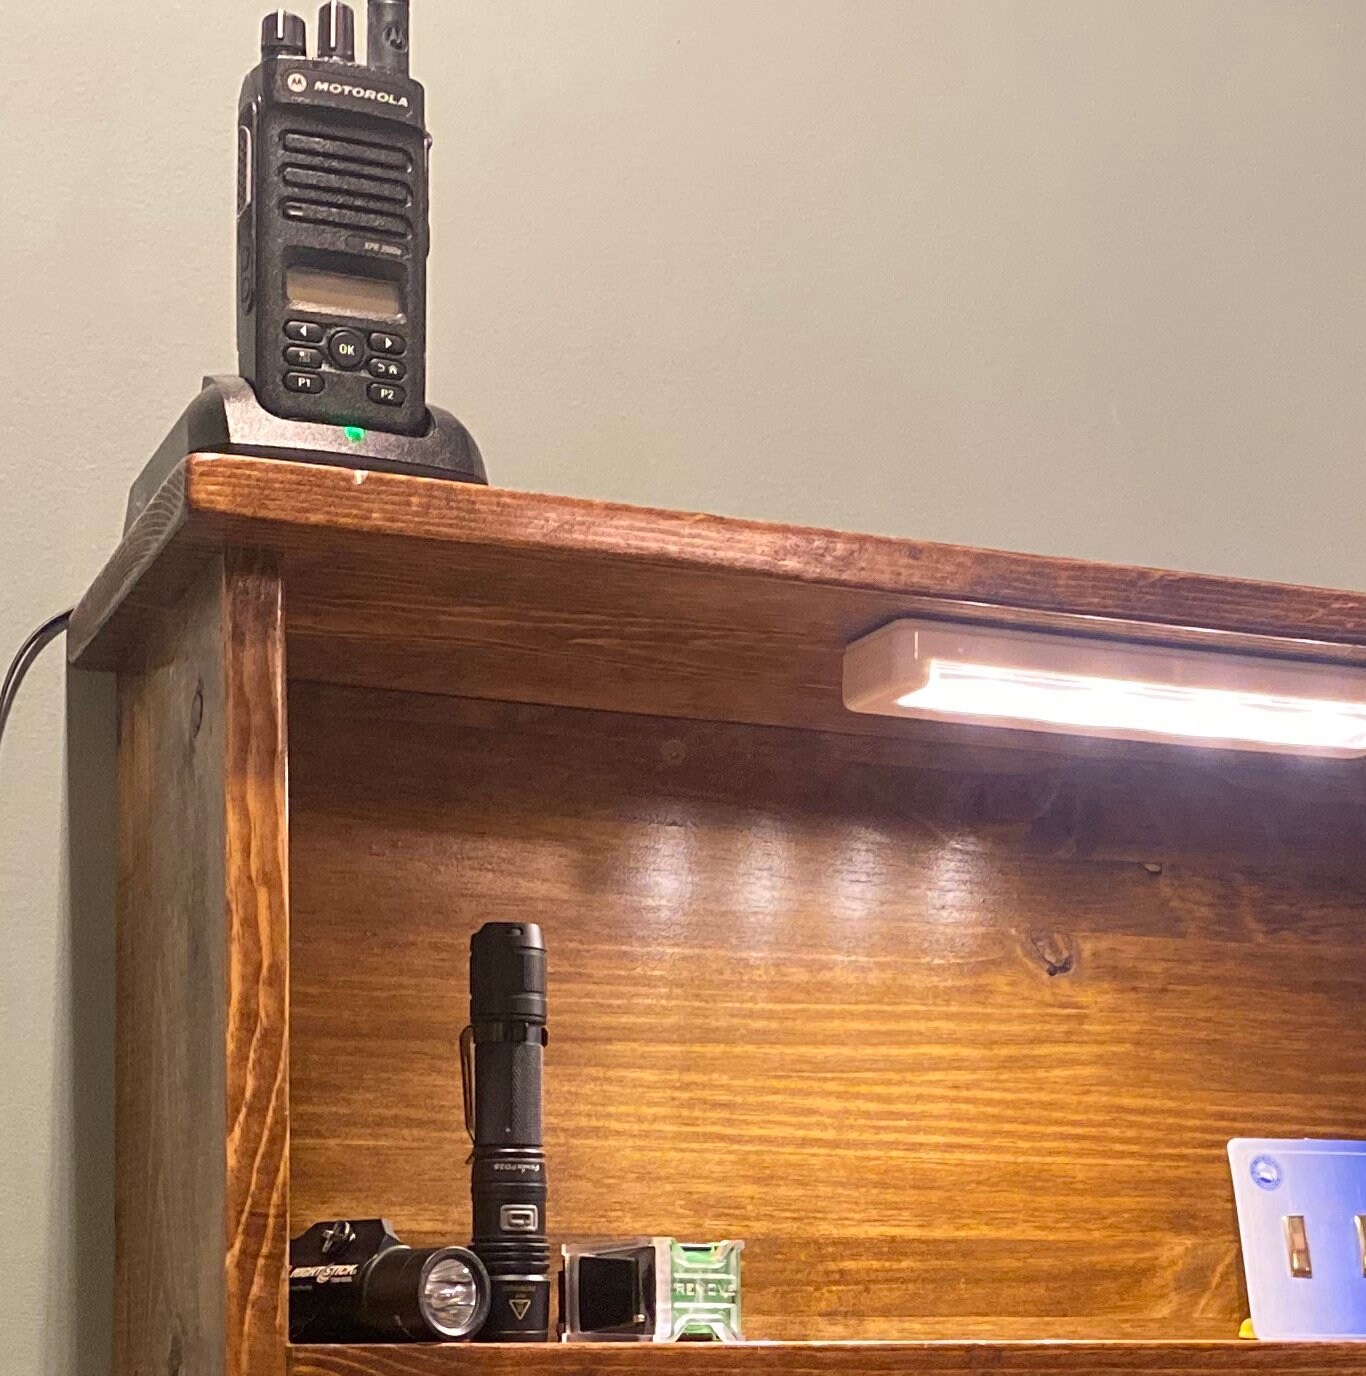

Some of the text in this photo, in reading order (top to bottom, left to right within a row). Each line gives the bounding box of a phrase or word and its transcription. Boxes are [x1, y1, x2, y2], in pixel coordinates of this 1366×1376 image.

[314, 80, 409, 108] MOTOROLA
[338, 343, 355, 356] OK
[298, 377, 311, 388] P1
[380, 388, 394, 400] P2
